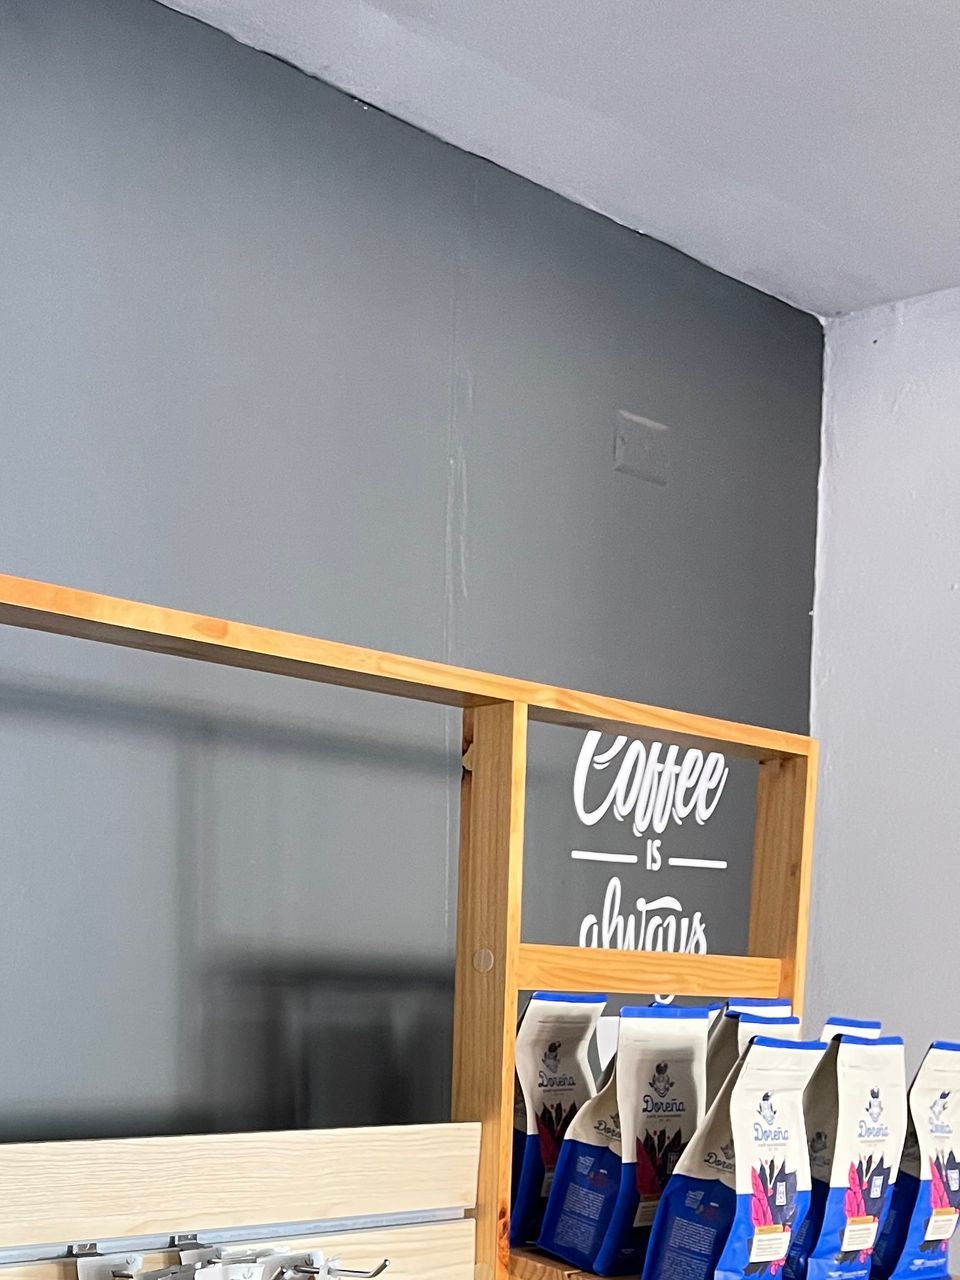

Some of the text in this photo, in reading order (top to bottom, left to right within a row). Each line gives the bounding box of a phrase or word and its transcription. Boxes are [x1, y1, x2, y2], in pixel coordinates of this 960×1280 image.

[573, 730, 728, 837] Coffee
[646, 839, 662, 871] IS
[642, 1095, 686, 1113] Doreña
[753, 1123, 789, 1141] Doreña
